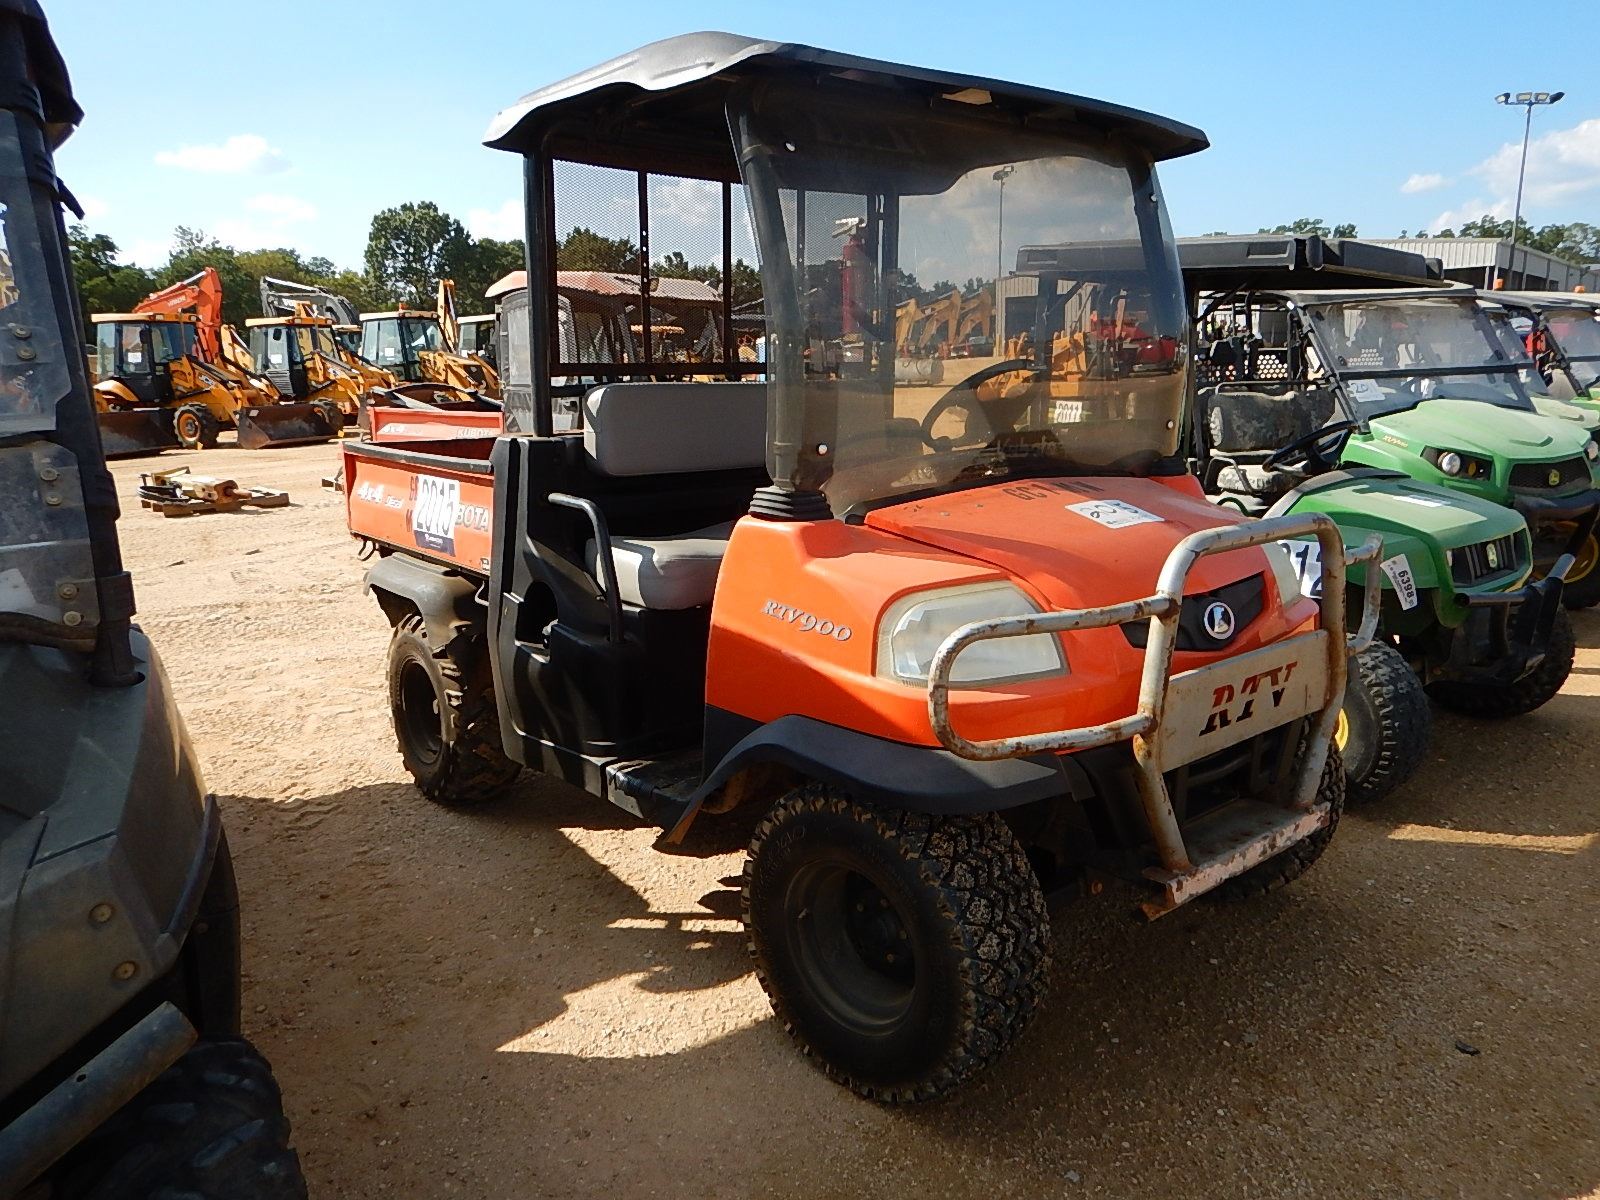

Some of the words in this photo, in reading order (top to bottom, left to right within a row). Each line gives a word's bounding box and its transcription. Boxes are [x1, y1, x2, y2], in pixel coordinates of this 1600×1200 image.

[455, 502, 489, 533] BOTA
[1397, 569, 1415, 598] 6398
[762, 599, 852, 641] RTV900
[1199, 661, 1298, 736] RTV
